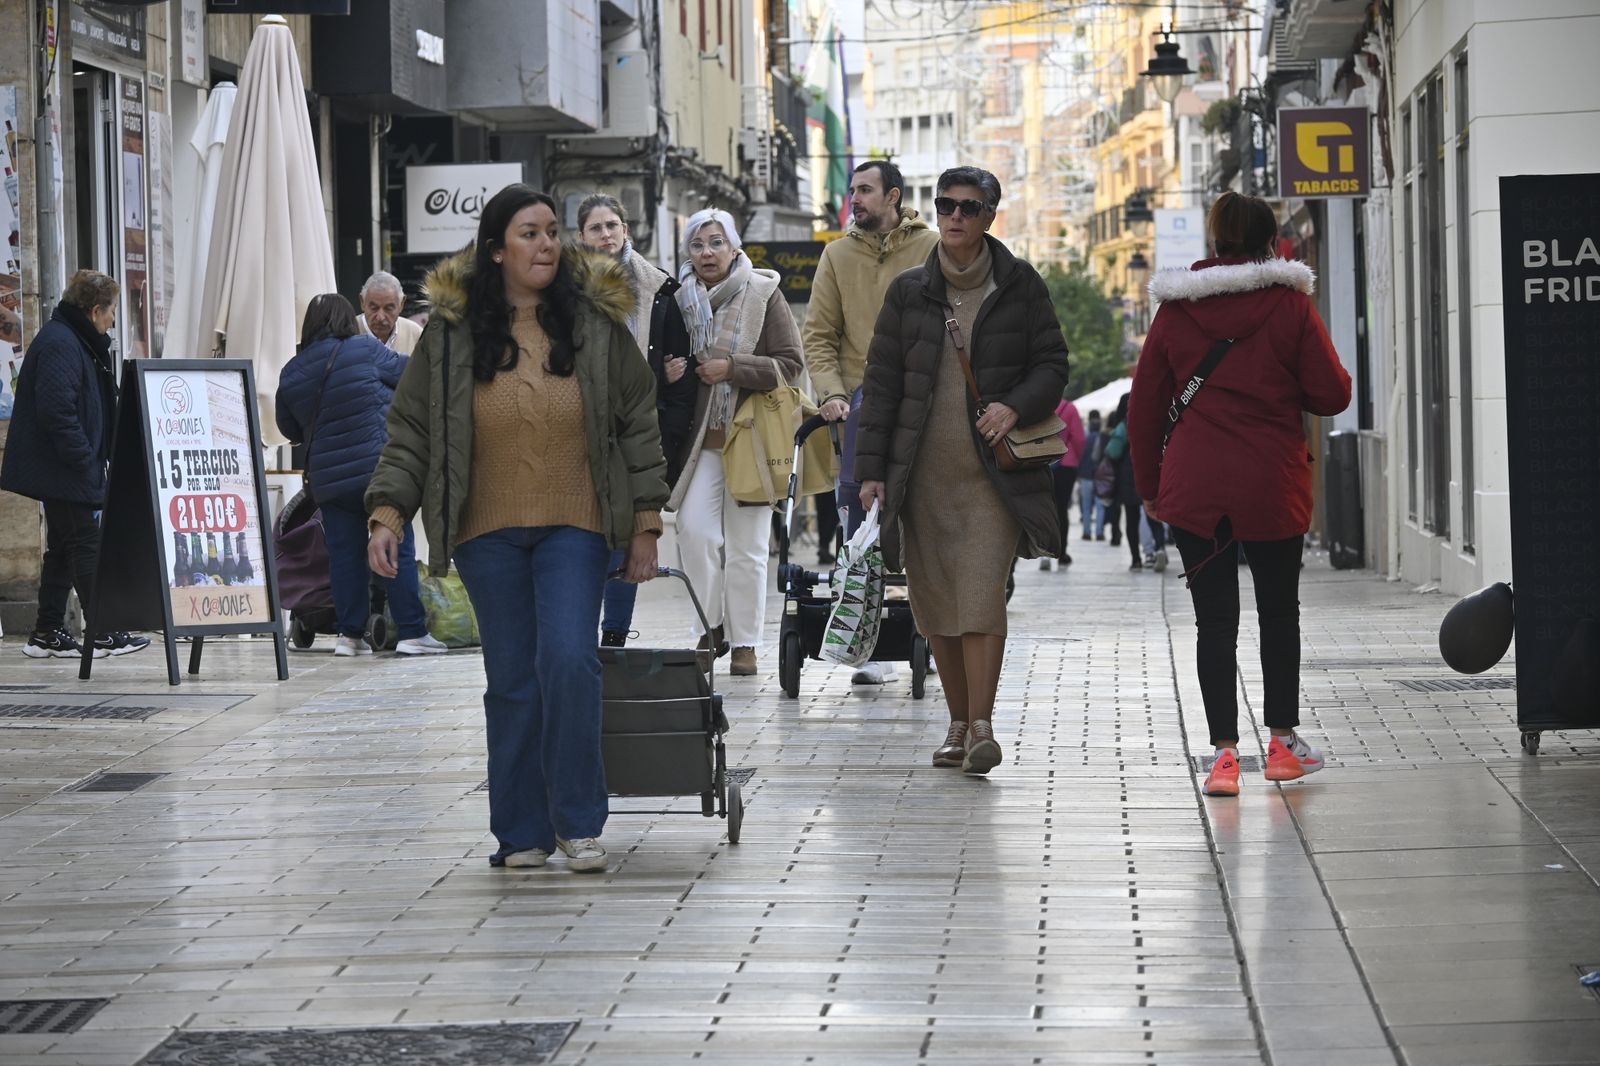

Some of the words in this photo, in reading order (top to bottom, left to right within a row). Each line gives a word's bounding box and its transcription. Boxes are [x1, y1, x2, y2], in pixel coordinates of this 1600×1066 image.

[1293, 178, 1360, 194] TABACOS
[1523, 237, 1600, 268] BLA
[1180, 375, 1205, 406] BIMBA
[183, 448, 240, 476] TERCIOS
[187, 478, 201, 491] POR
[204, 477, 221, 491] SOLO
[177, 496, 238, 533] 21,90€
[202, 594, 253, 617] C@JONES
